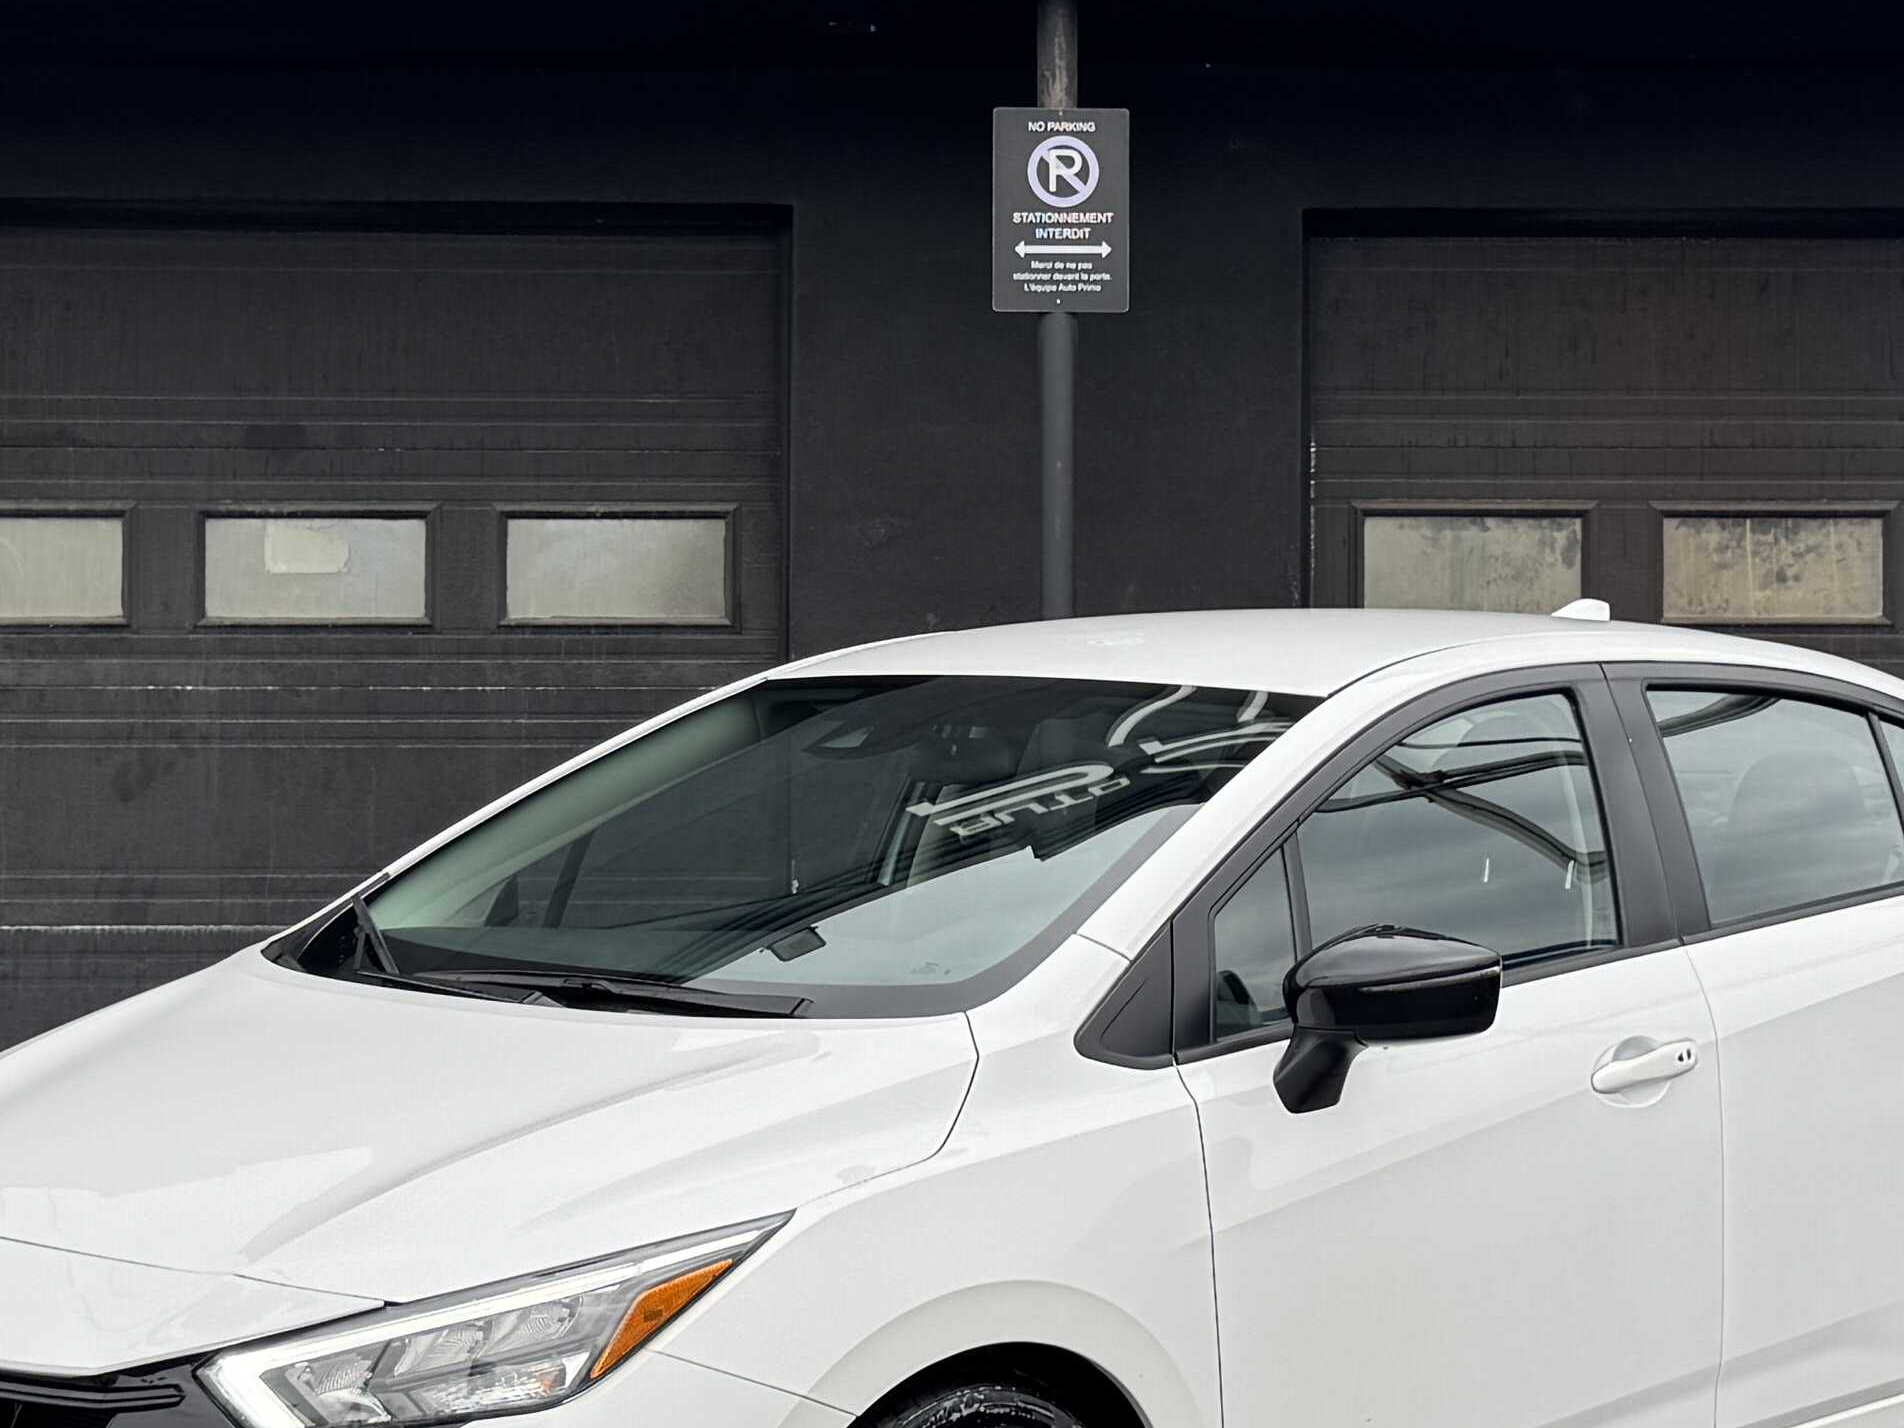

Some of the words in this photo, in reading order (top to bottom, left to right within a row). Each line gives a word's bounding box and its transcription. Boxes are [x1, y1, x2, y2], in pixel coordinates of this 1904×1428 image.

[1028, 120, 1045, 132] NO
[1047, 121, 1096, 132] PARKING
[1012, 212, 1115, 224] STATIONNEMENT
[1035, 228, 1092, 240] INTERDIT
